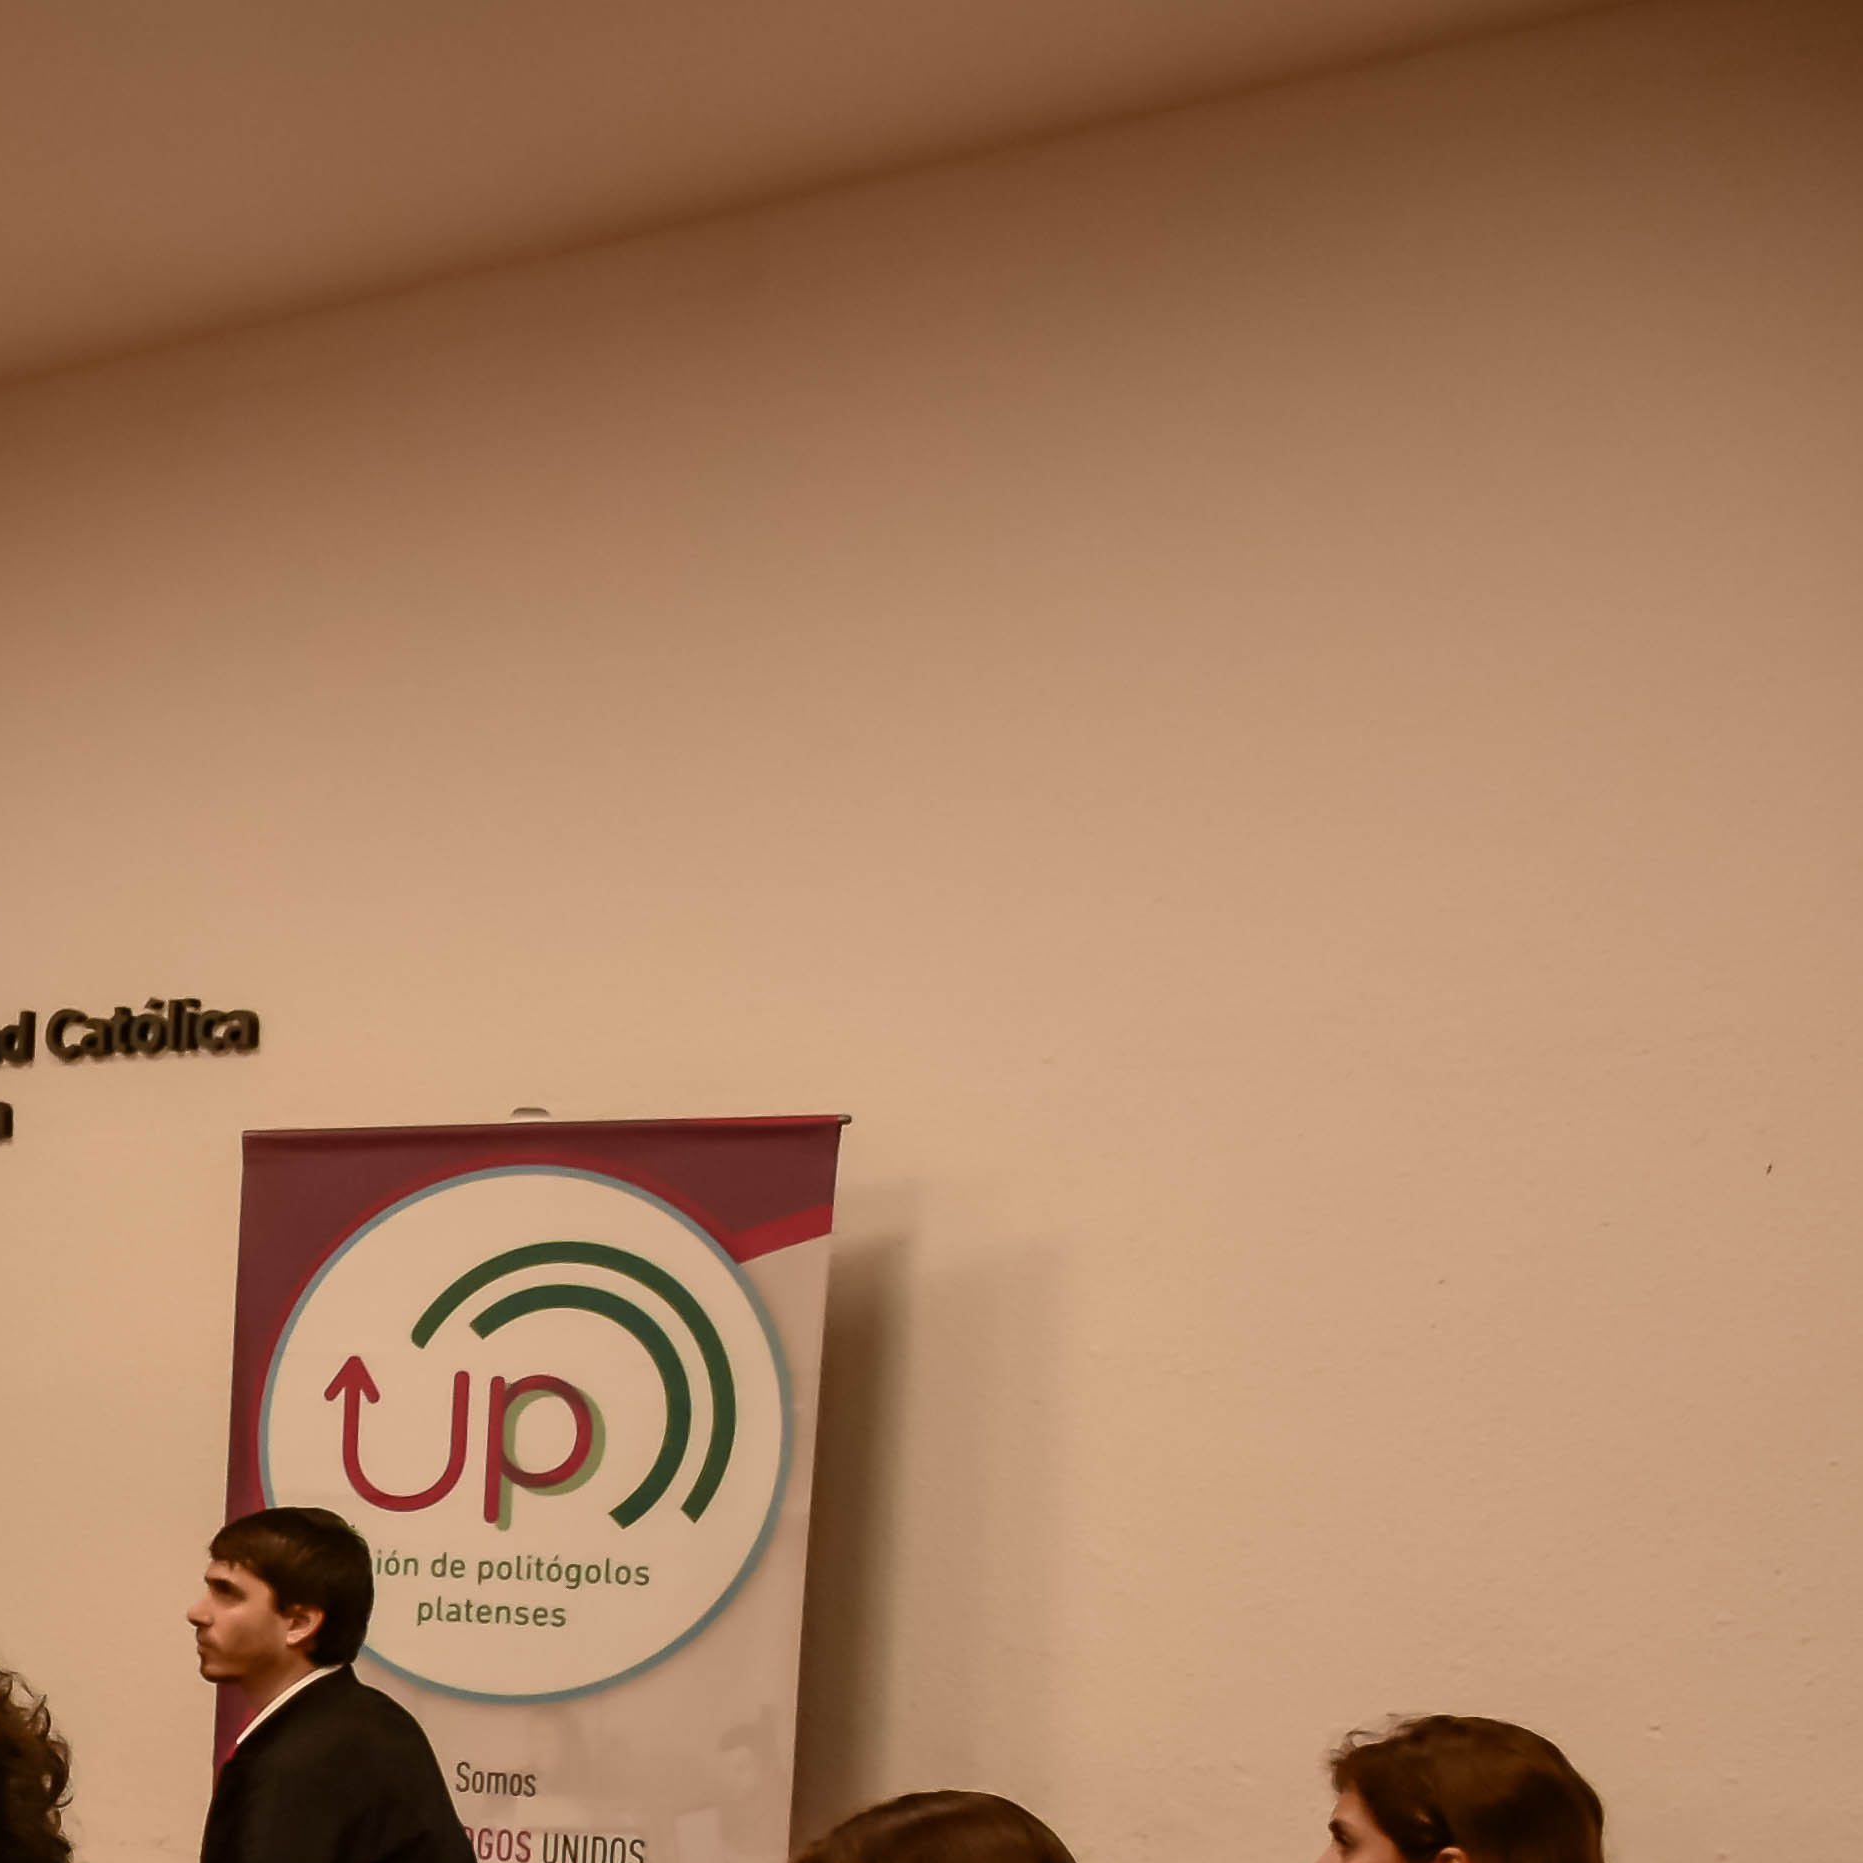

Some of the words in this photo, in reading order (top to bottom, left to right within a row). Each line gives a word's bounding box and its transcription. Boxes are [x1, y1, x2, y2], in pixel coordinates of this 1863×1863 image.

[46, 998, 260, 1062] Católica
[376, 1550, 419, 1576] ión
[430, 1551, 466, 1579] de
[477, 1555, 650, 1589] politógolos
[417, 1596, 567, 1628] platenses
[455, 1762, 537, 1798] Somos
